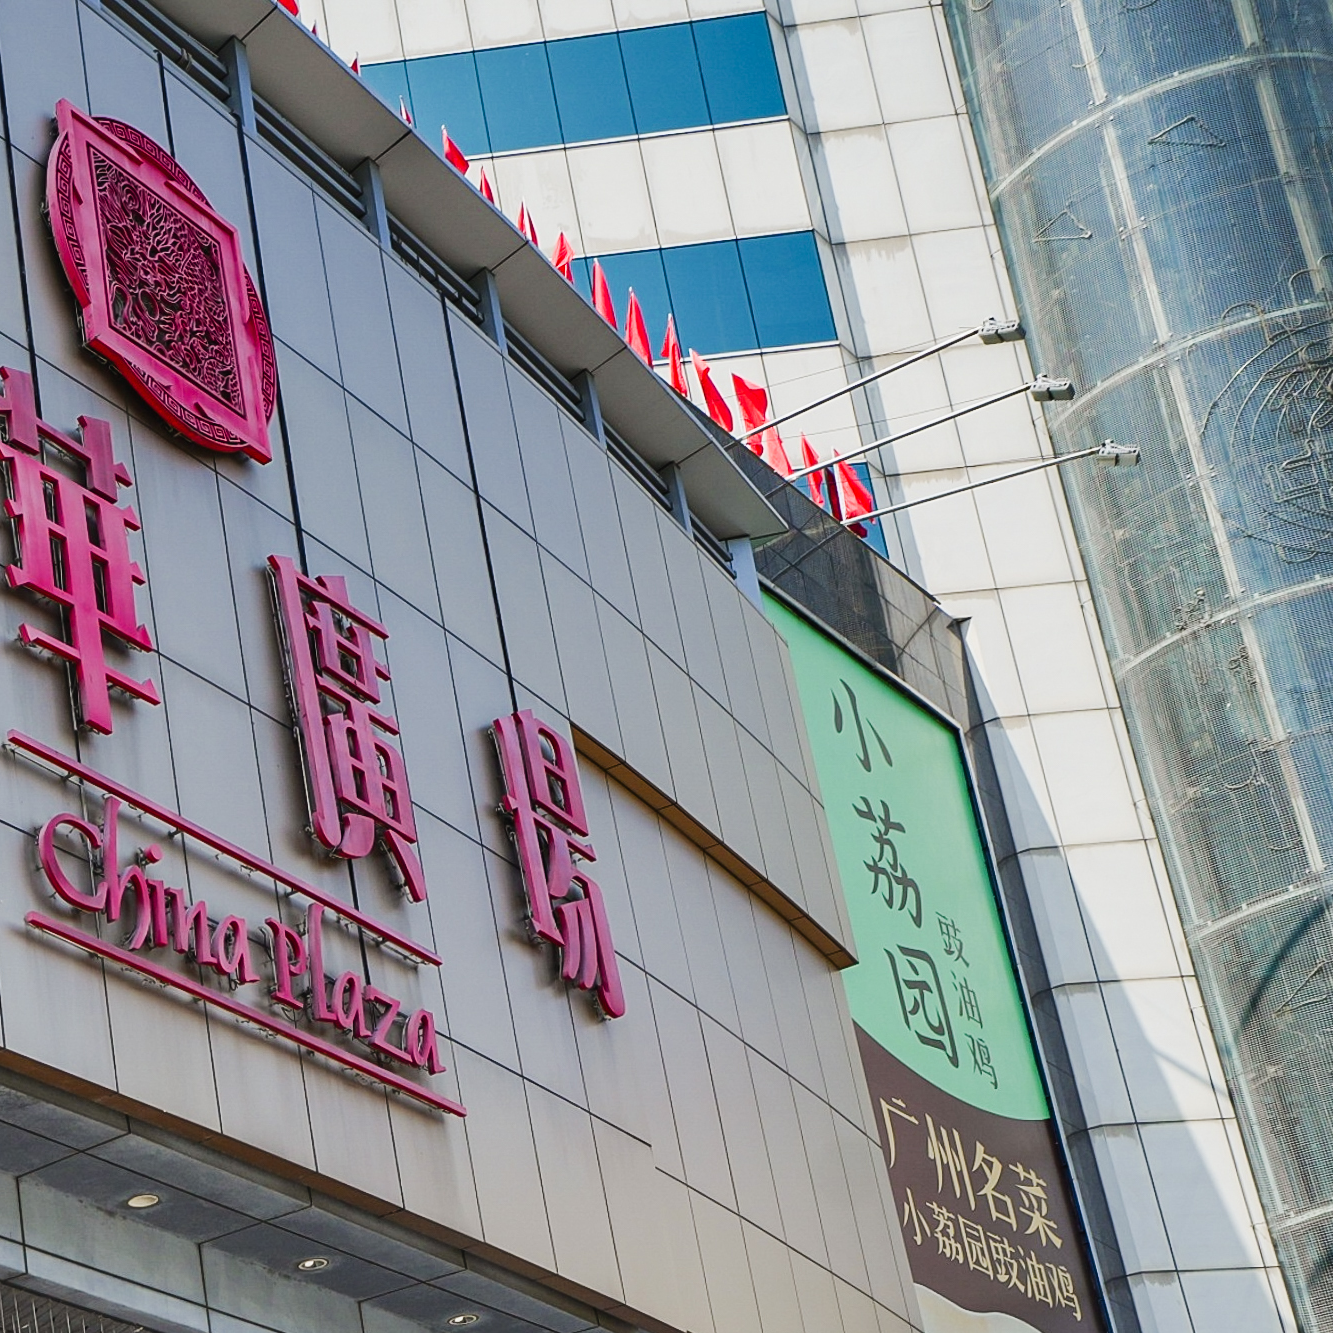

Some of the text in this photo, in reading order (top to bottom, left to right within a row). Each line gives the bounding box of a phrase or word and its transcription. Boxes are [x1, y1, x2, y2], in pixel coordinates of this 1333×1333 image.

[37, 794, 447, 1076] China Plaza
[830, 677, 961, 1069] 小荔园
[935, 910, 1000, 1091] 豉油鸡
[879, 1096, 1064, 1249] 广州名菜
[902, 1186, 1083, 1322] 小荔园豉油鸡
